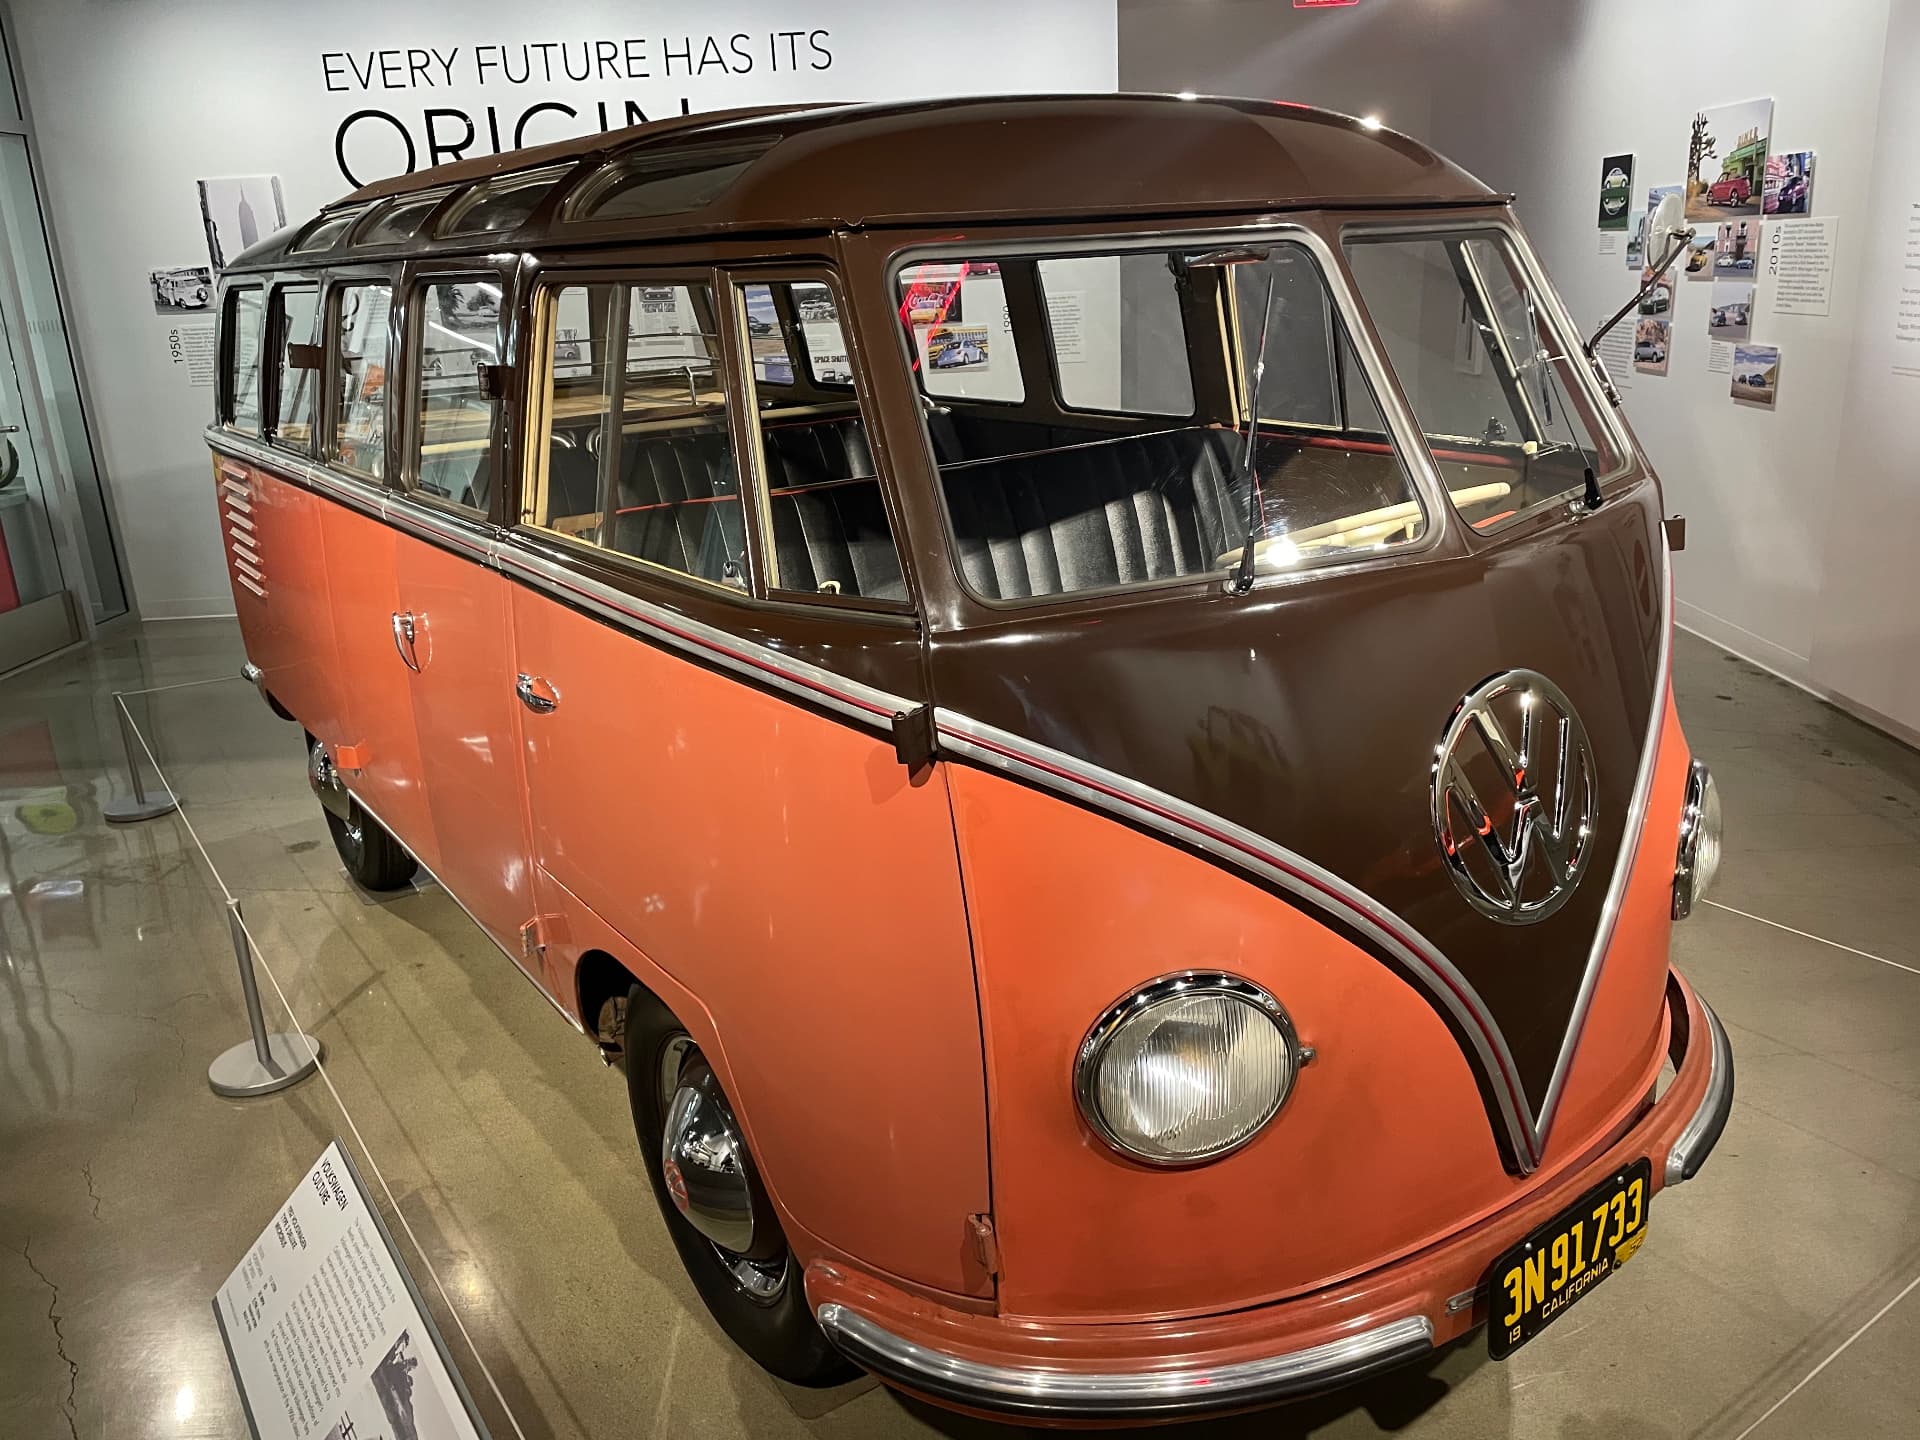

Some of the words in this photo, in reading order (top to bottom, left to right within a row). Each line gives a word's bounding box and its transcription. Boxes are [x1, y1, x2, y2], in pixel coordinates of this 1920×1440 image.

[322, 47, 459, 92] EVERY
[476, 39, 650, 85] FUTURE
[663, 33, 753, 77] HAS
[770, 30, 832, 71] ITS
[1769, 225, 1782, 275] 2010s
[168, 328, 184, 364] 1950s
[311, 1170, 331, 1206] CULTURE
[321, 1156, 348, 1211] VOLKSWAGEN
[1542, 1258, 1609, 1320] CALIFORNIA
